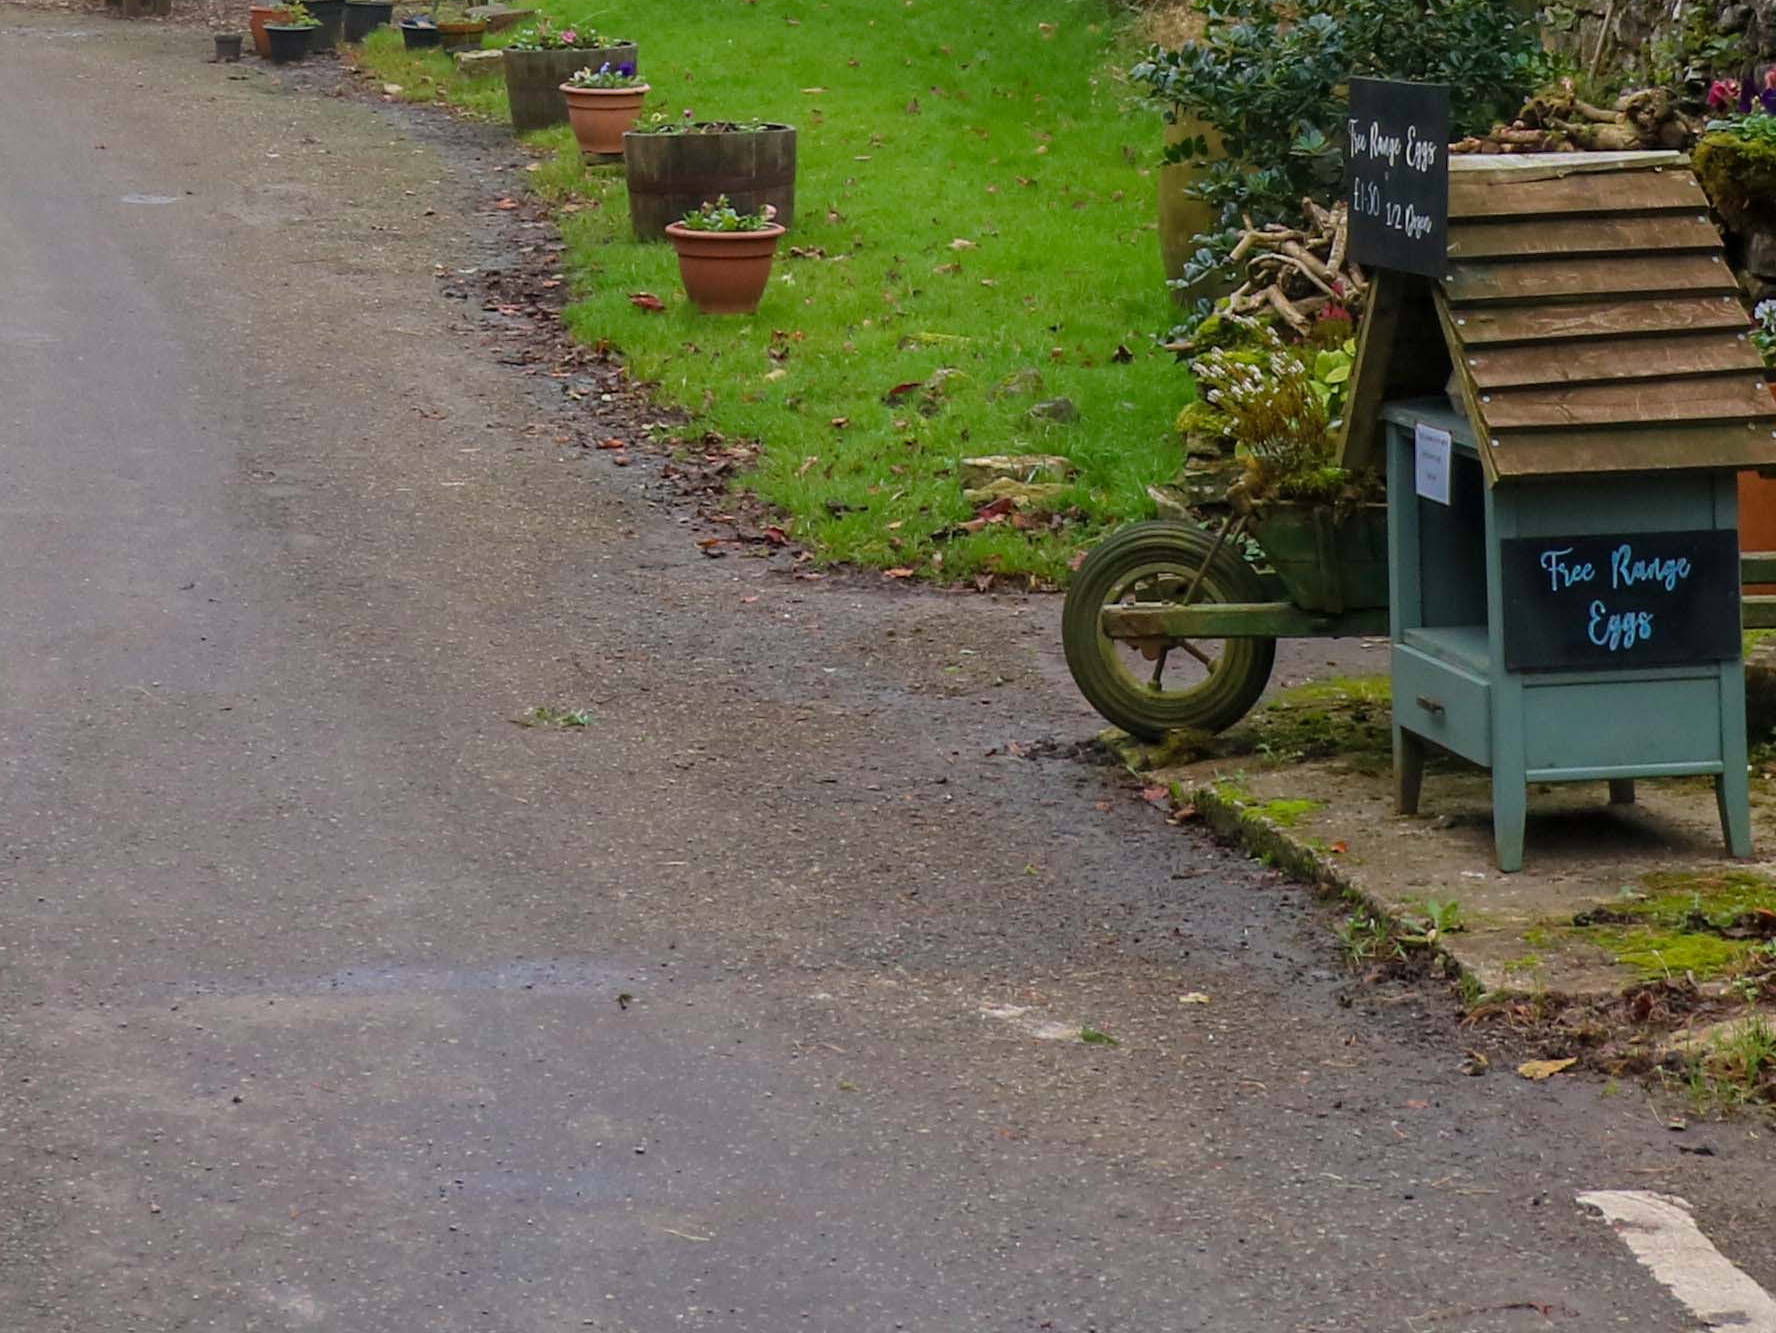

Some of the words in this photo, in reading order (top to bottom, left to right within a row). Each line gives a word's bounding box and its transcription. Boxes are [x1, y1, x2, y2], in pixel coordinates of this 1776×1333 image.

[1348, 118, 1366, 158] Free
[1370, 121, 1401, 167] Range
[1406, 125, 1437, 172] Eggs
[1405, 204, 1432, 239] Dozen
[1540, 547, 1595, 591] Free
[1611, 543, 1691, 591] Range
[1588, 599, 1654, 651] Eggs
